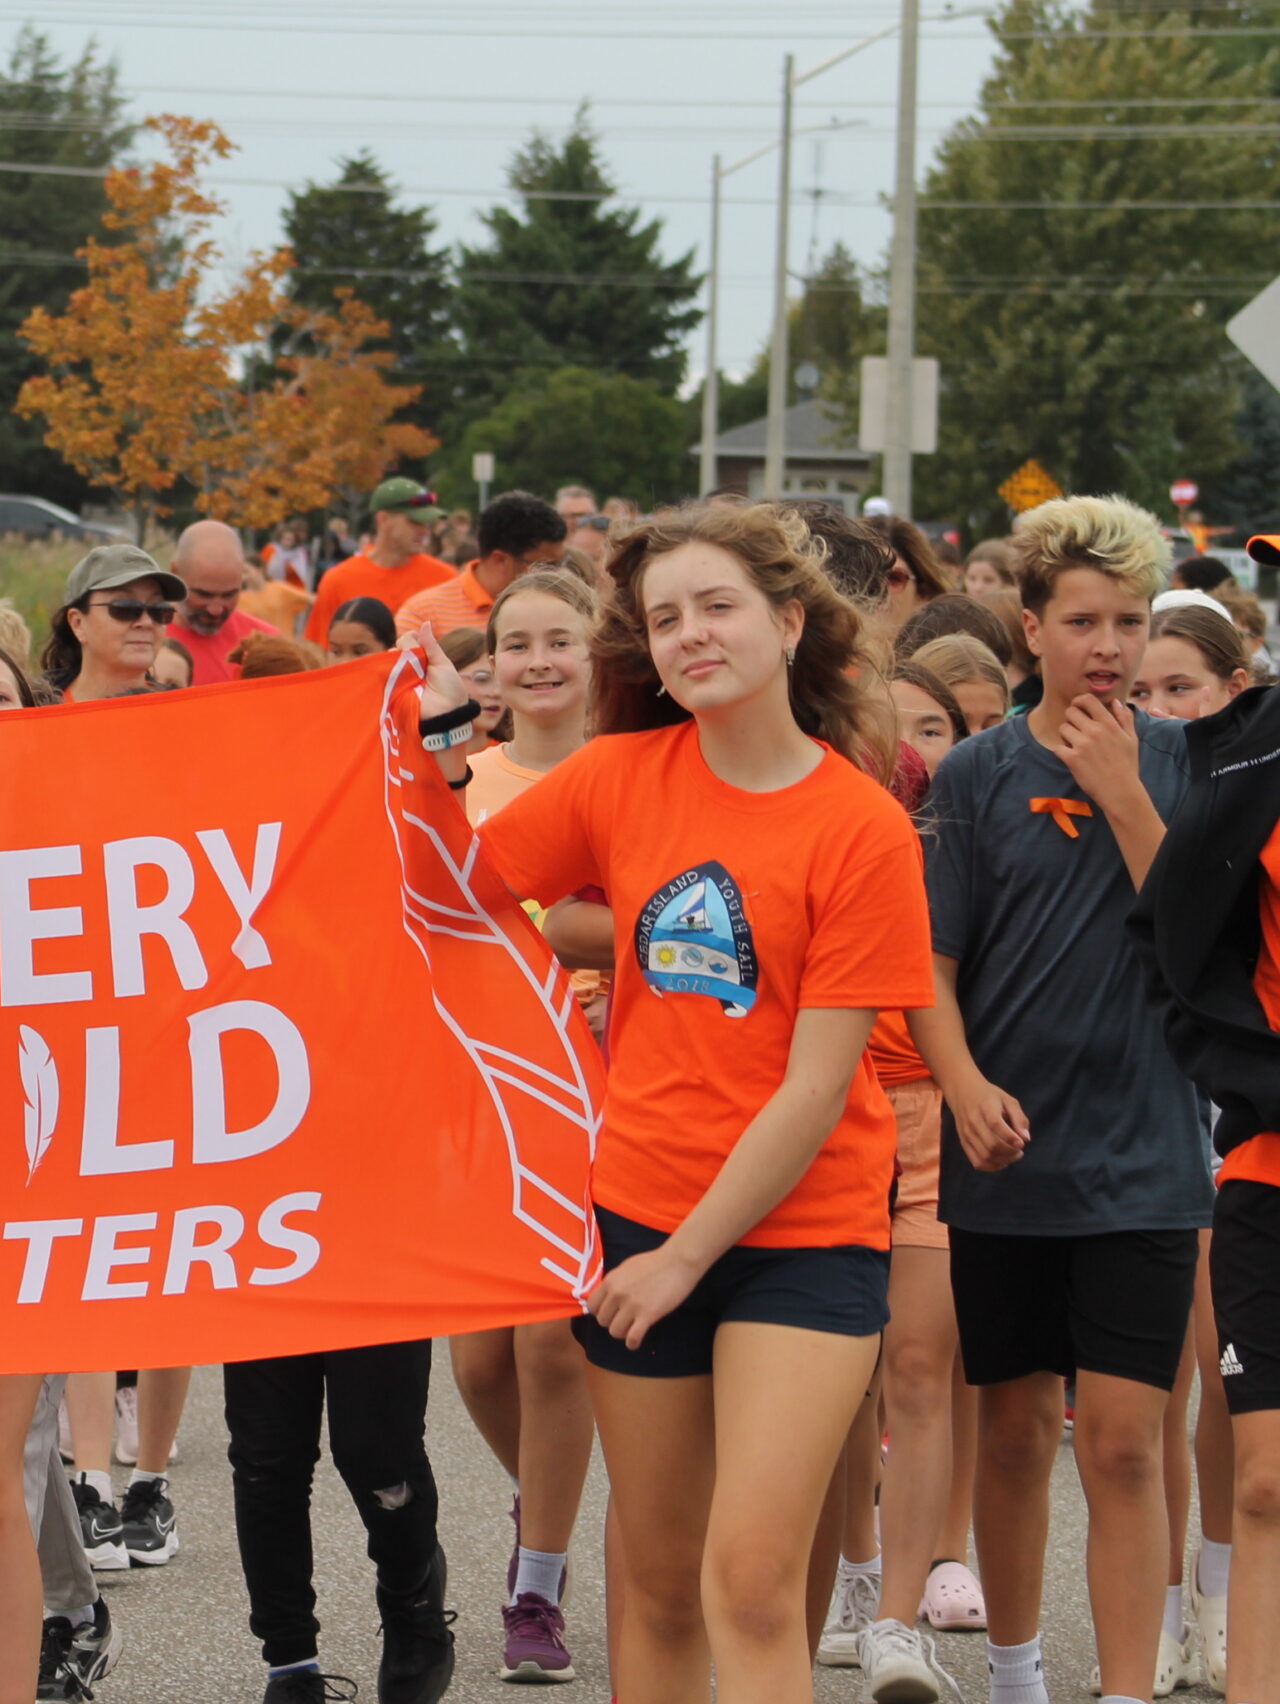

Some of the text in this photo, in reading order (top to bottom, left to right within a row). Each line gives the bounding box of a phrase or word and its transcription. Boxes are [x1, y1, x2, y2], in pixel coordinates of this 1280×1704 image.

[638, 871, 699, 965] CEDAR ISLAND
[719, 878, 754, 982] YOUTH SAIL
[665, 976, 712, 992] 2018
